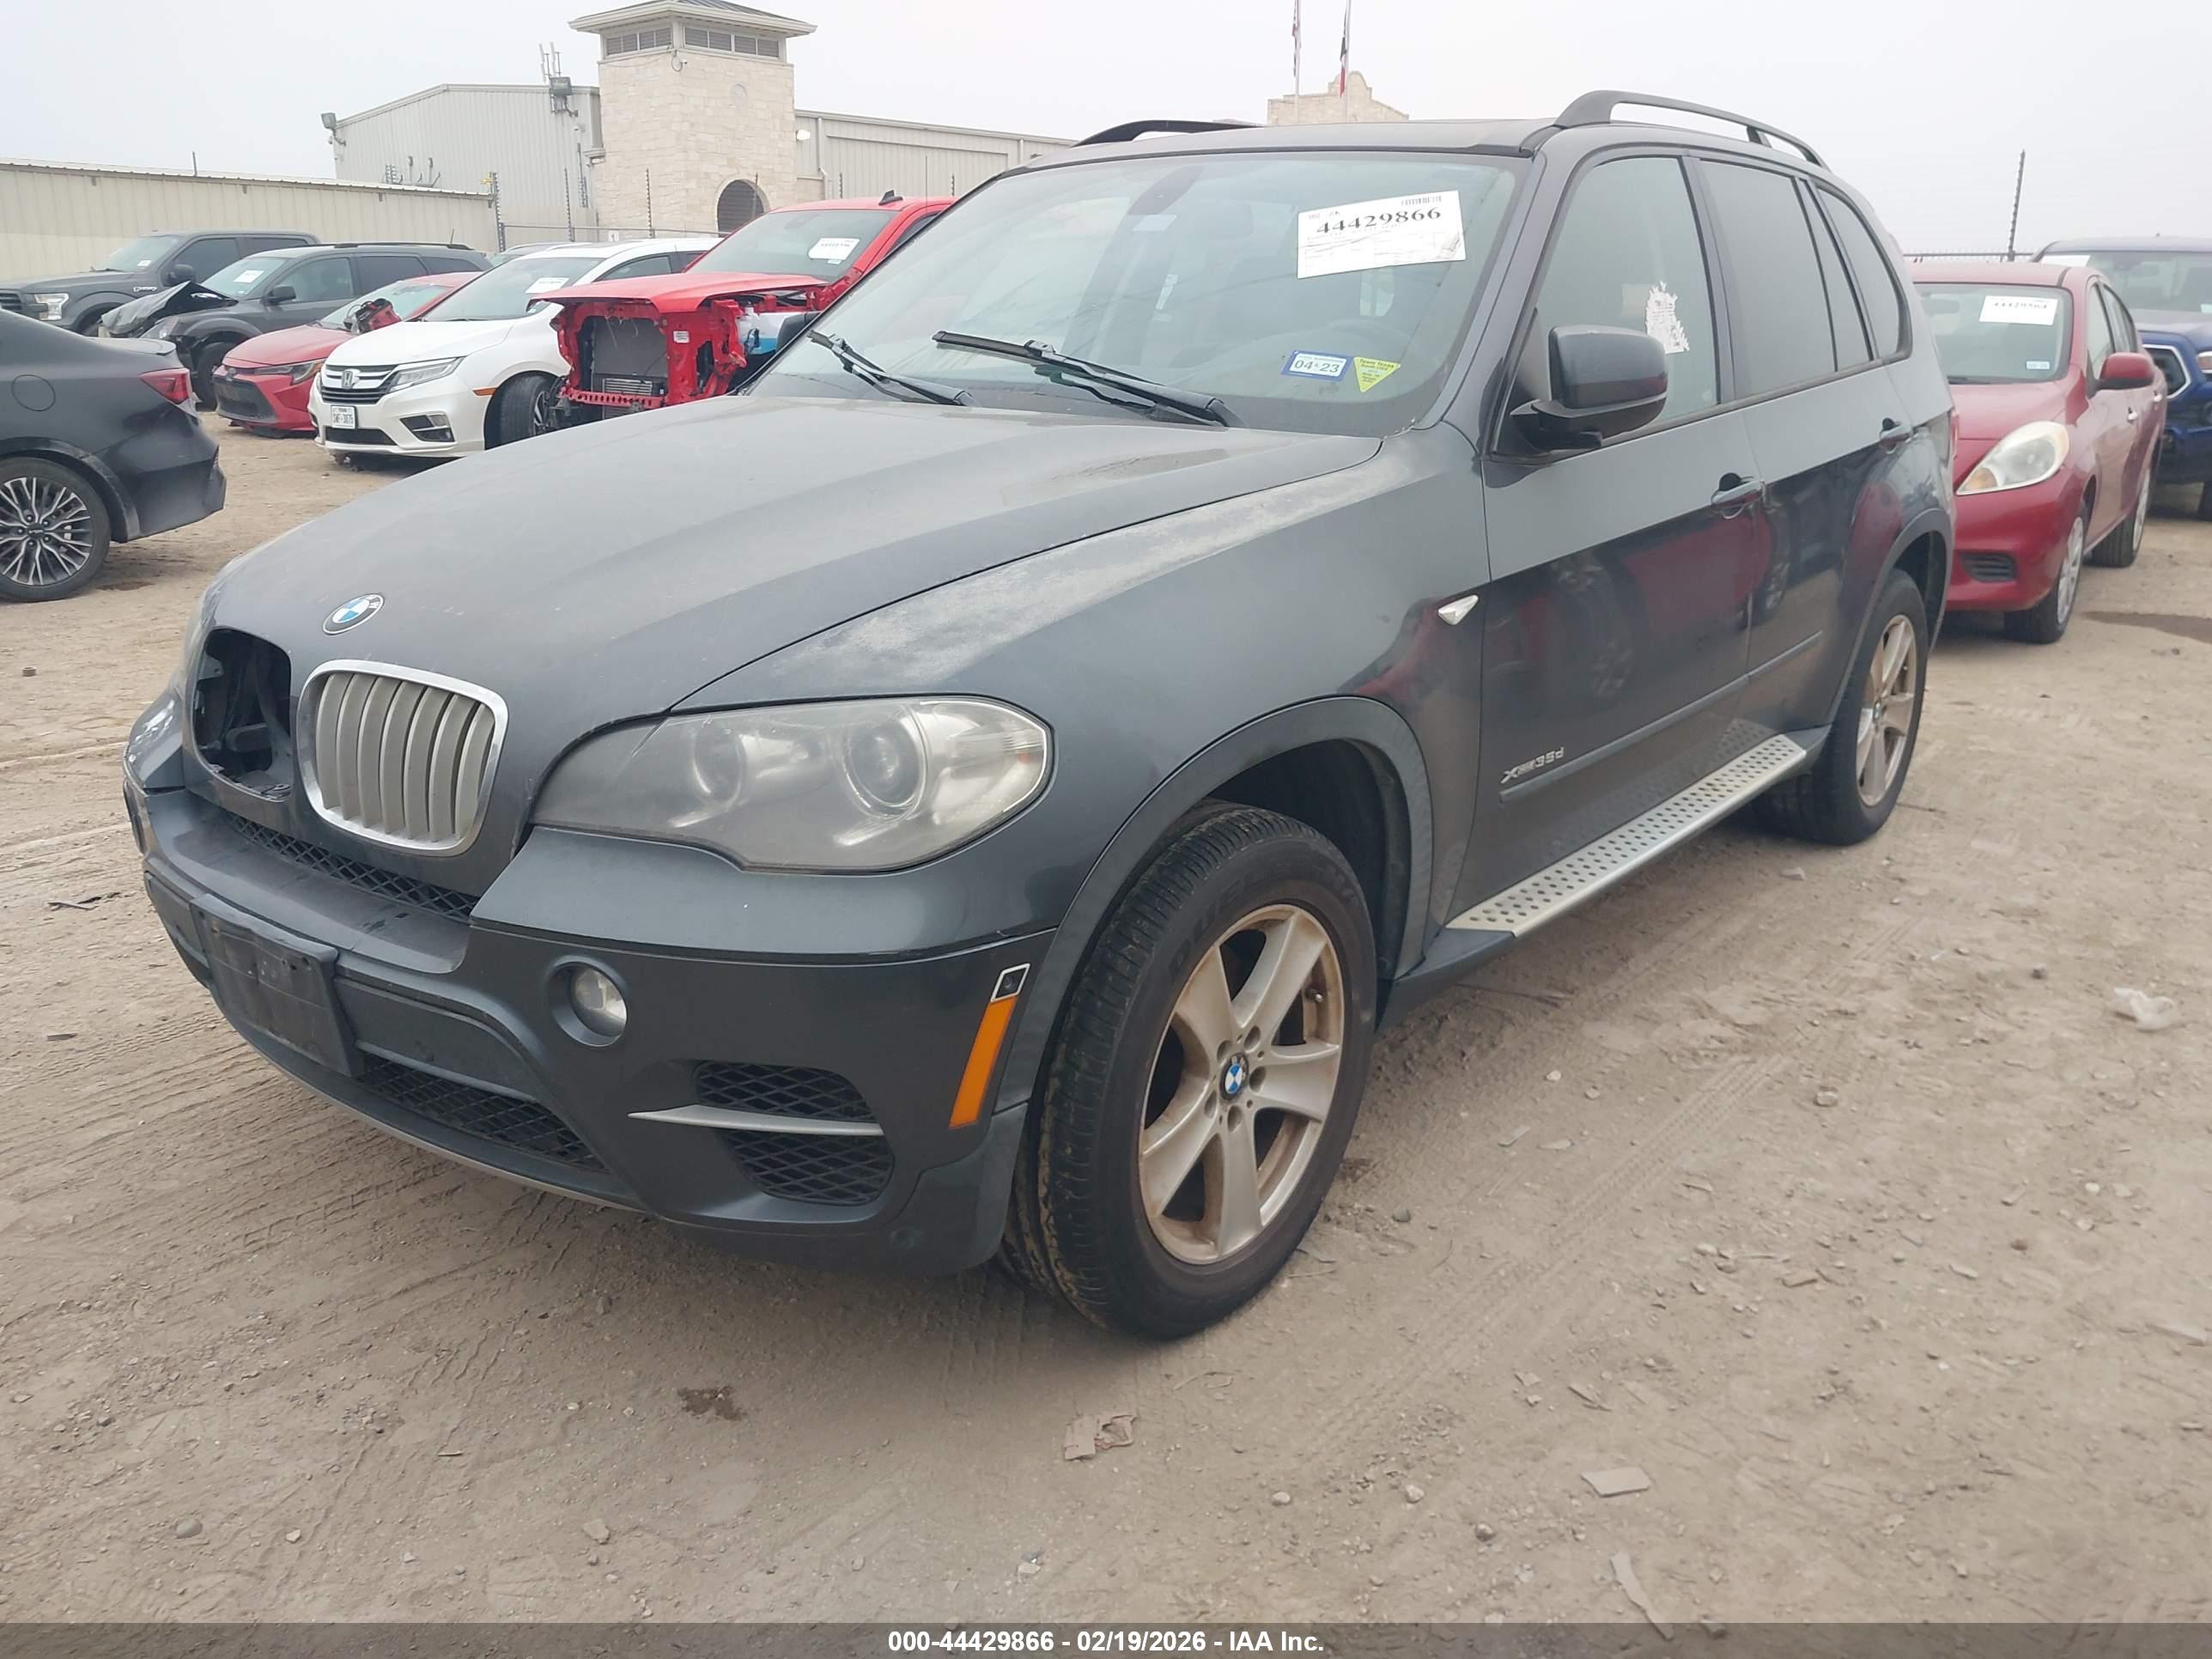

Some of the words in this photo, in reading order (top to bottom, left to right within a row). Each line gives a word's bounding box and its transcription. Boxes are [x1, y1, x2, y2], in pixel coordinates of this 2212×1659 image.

[1316, 207, 1442, 234] 44429866
[1295, 360, 1314, 370] 04
[1319, 362, 1340, 374] 23
